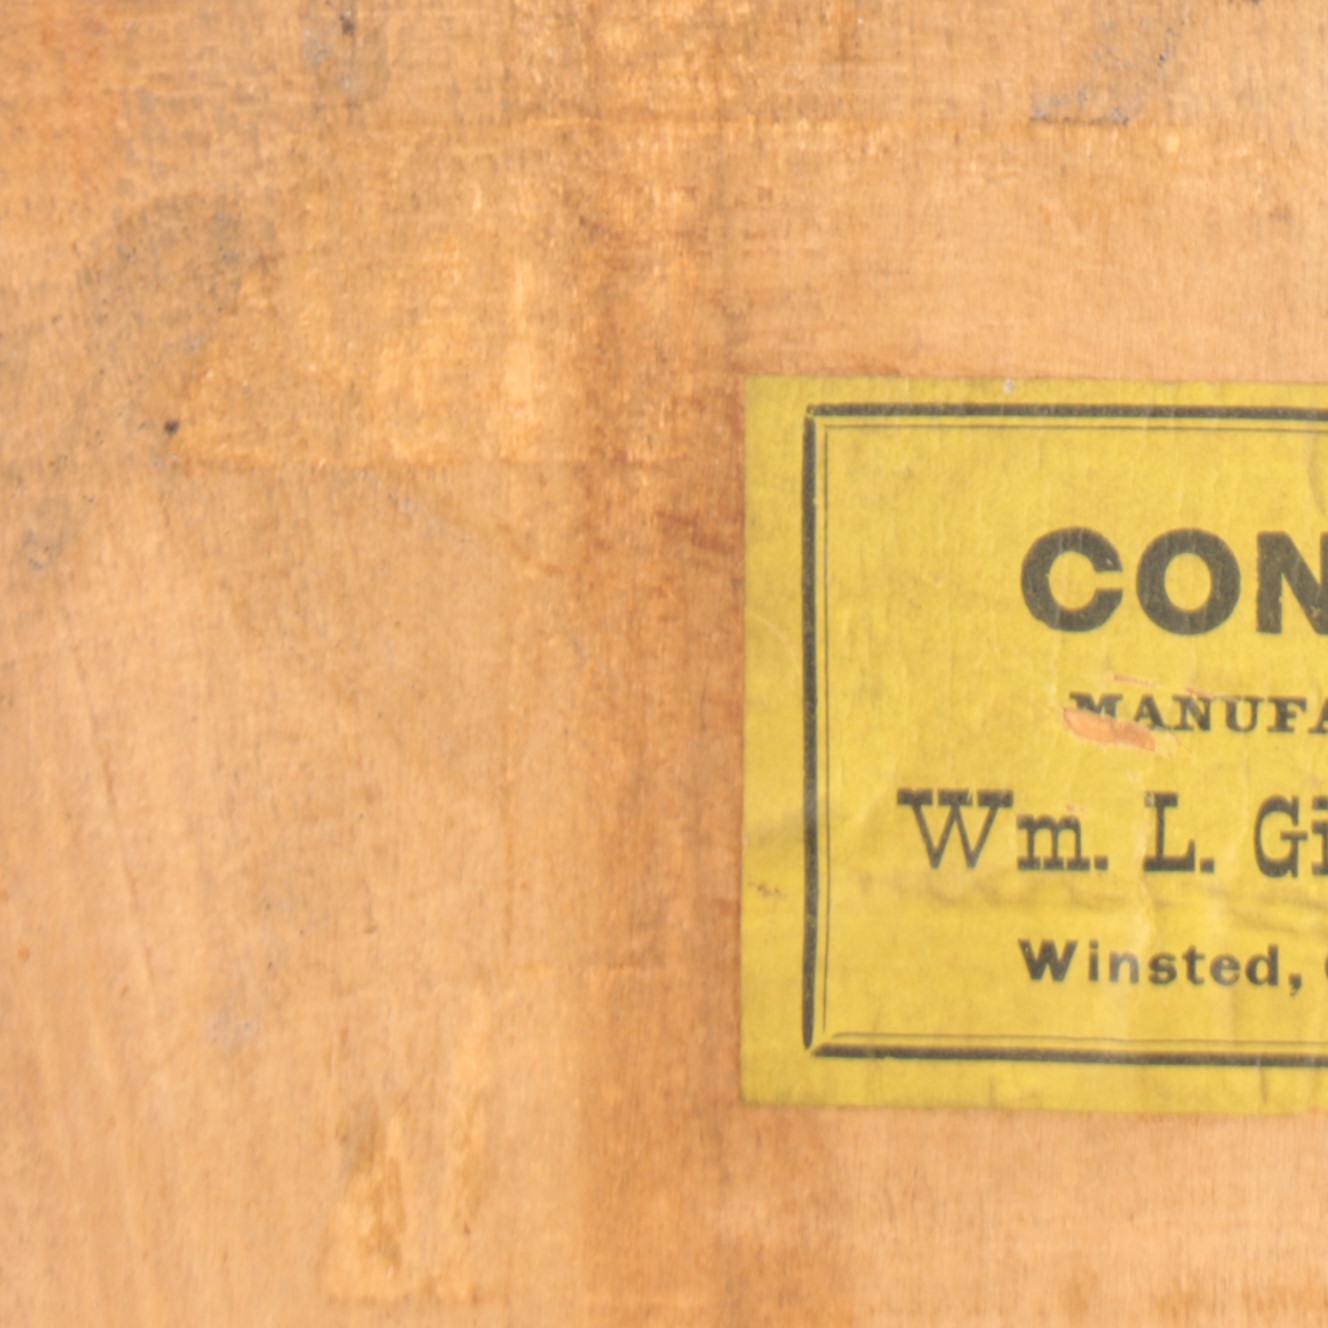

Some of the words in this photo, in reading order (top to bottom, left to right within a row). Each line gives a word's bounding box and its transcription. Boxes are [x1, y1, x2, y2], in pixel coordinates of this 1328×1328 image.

[896, 788, 1110, 872] Wm.
[1142, 792, 1216, 875] L.
[1018, 940, 1304, 993] Winsted,
